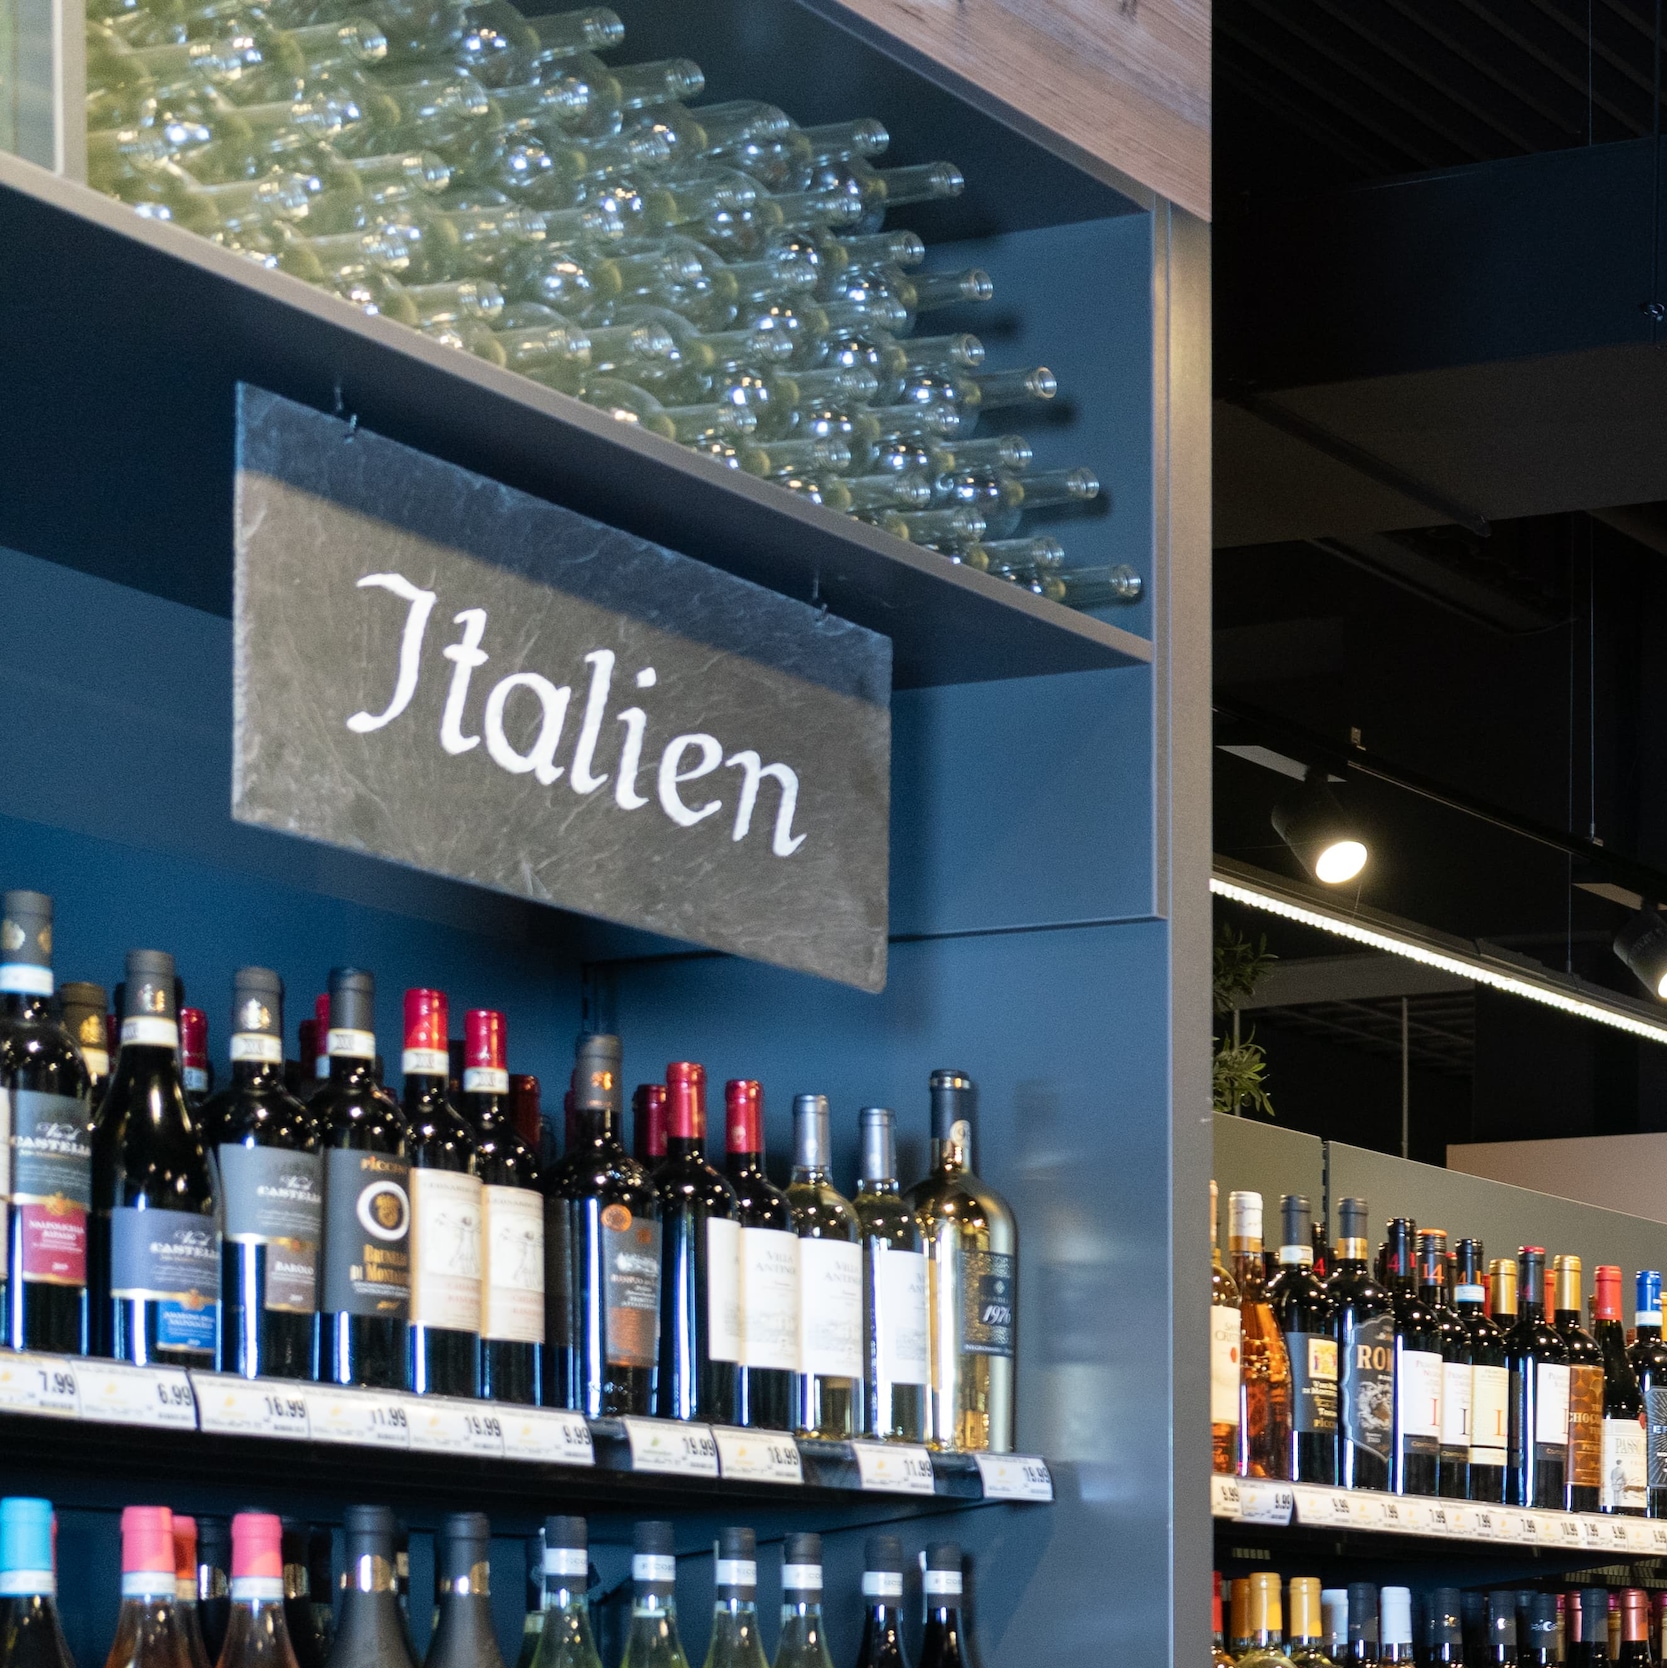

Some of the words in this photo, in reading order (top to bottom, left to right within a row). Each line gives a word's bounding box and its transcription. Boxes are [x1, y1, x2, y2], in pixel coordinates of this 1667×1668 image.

[346, 572, 807, 857] Italien
[38, 1371, 76, 1395] 7.99
[158, 1381, 192, 1406] 6.99
[265, 1394, 306, 1418] 16.99
[465, 1415, 502, 1438] 19.99
